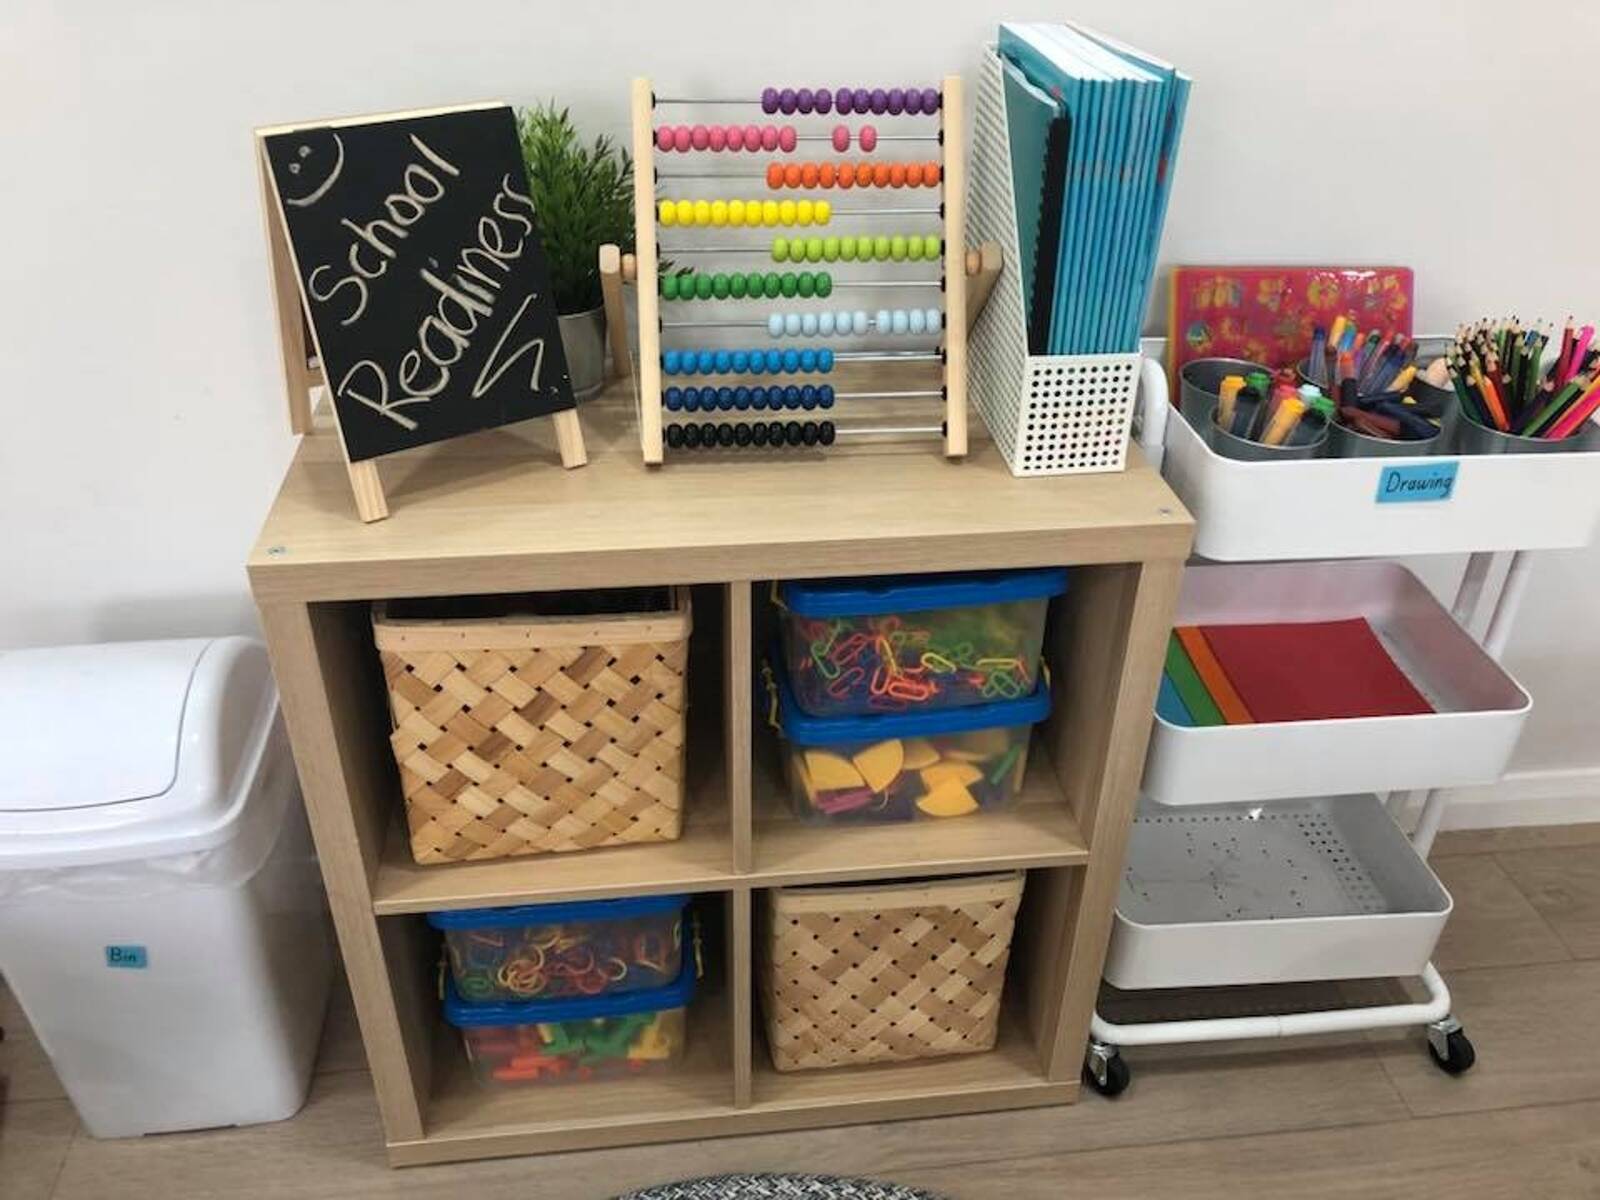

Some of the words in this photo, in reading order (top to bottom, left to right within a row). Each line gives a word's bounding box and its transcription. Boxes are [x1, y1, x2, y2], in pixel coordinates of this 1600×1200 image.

[309, 133, 460, 326] School
[337, 173, 536, 430] Readiness
[1385, 470, 1454, 499] Drawing
[110, 946, 137, 962] Bin
